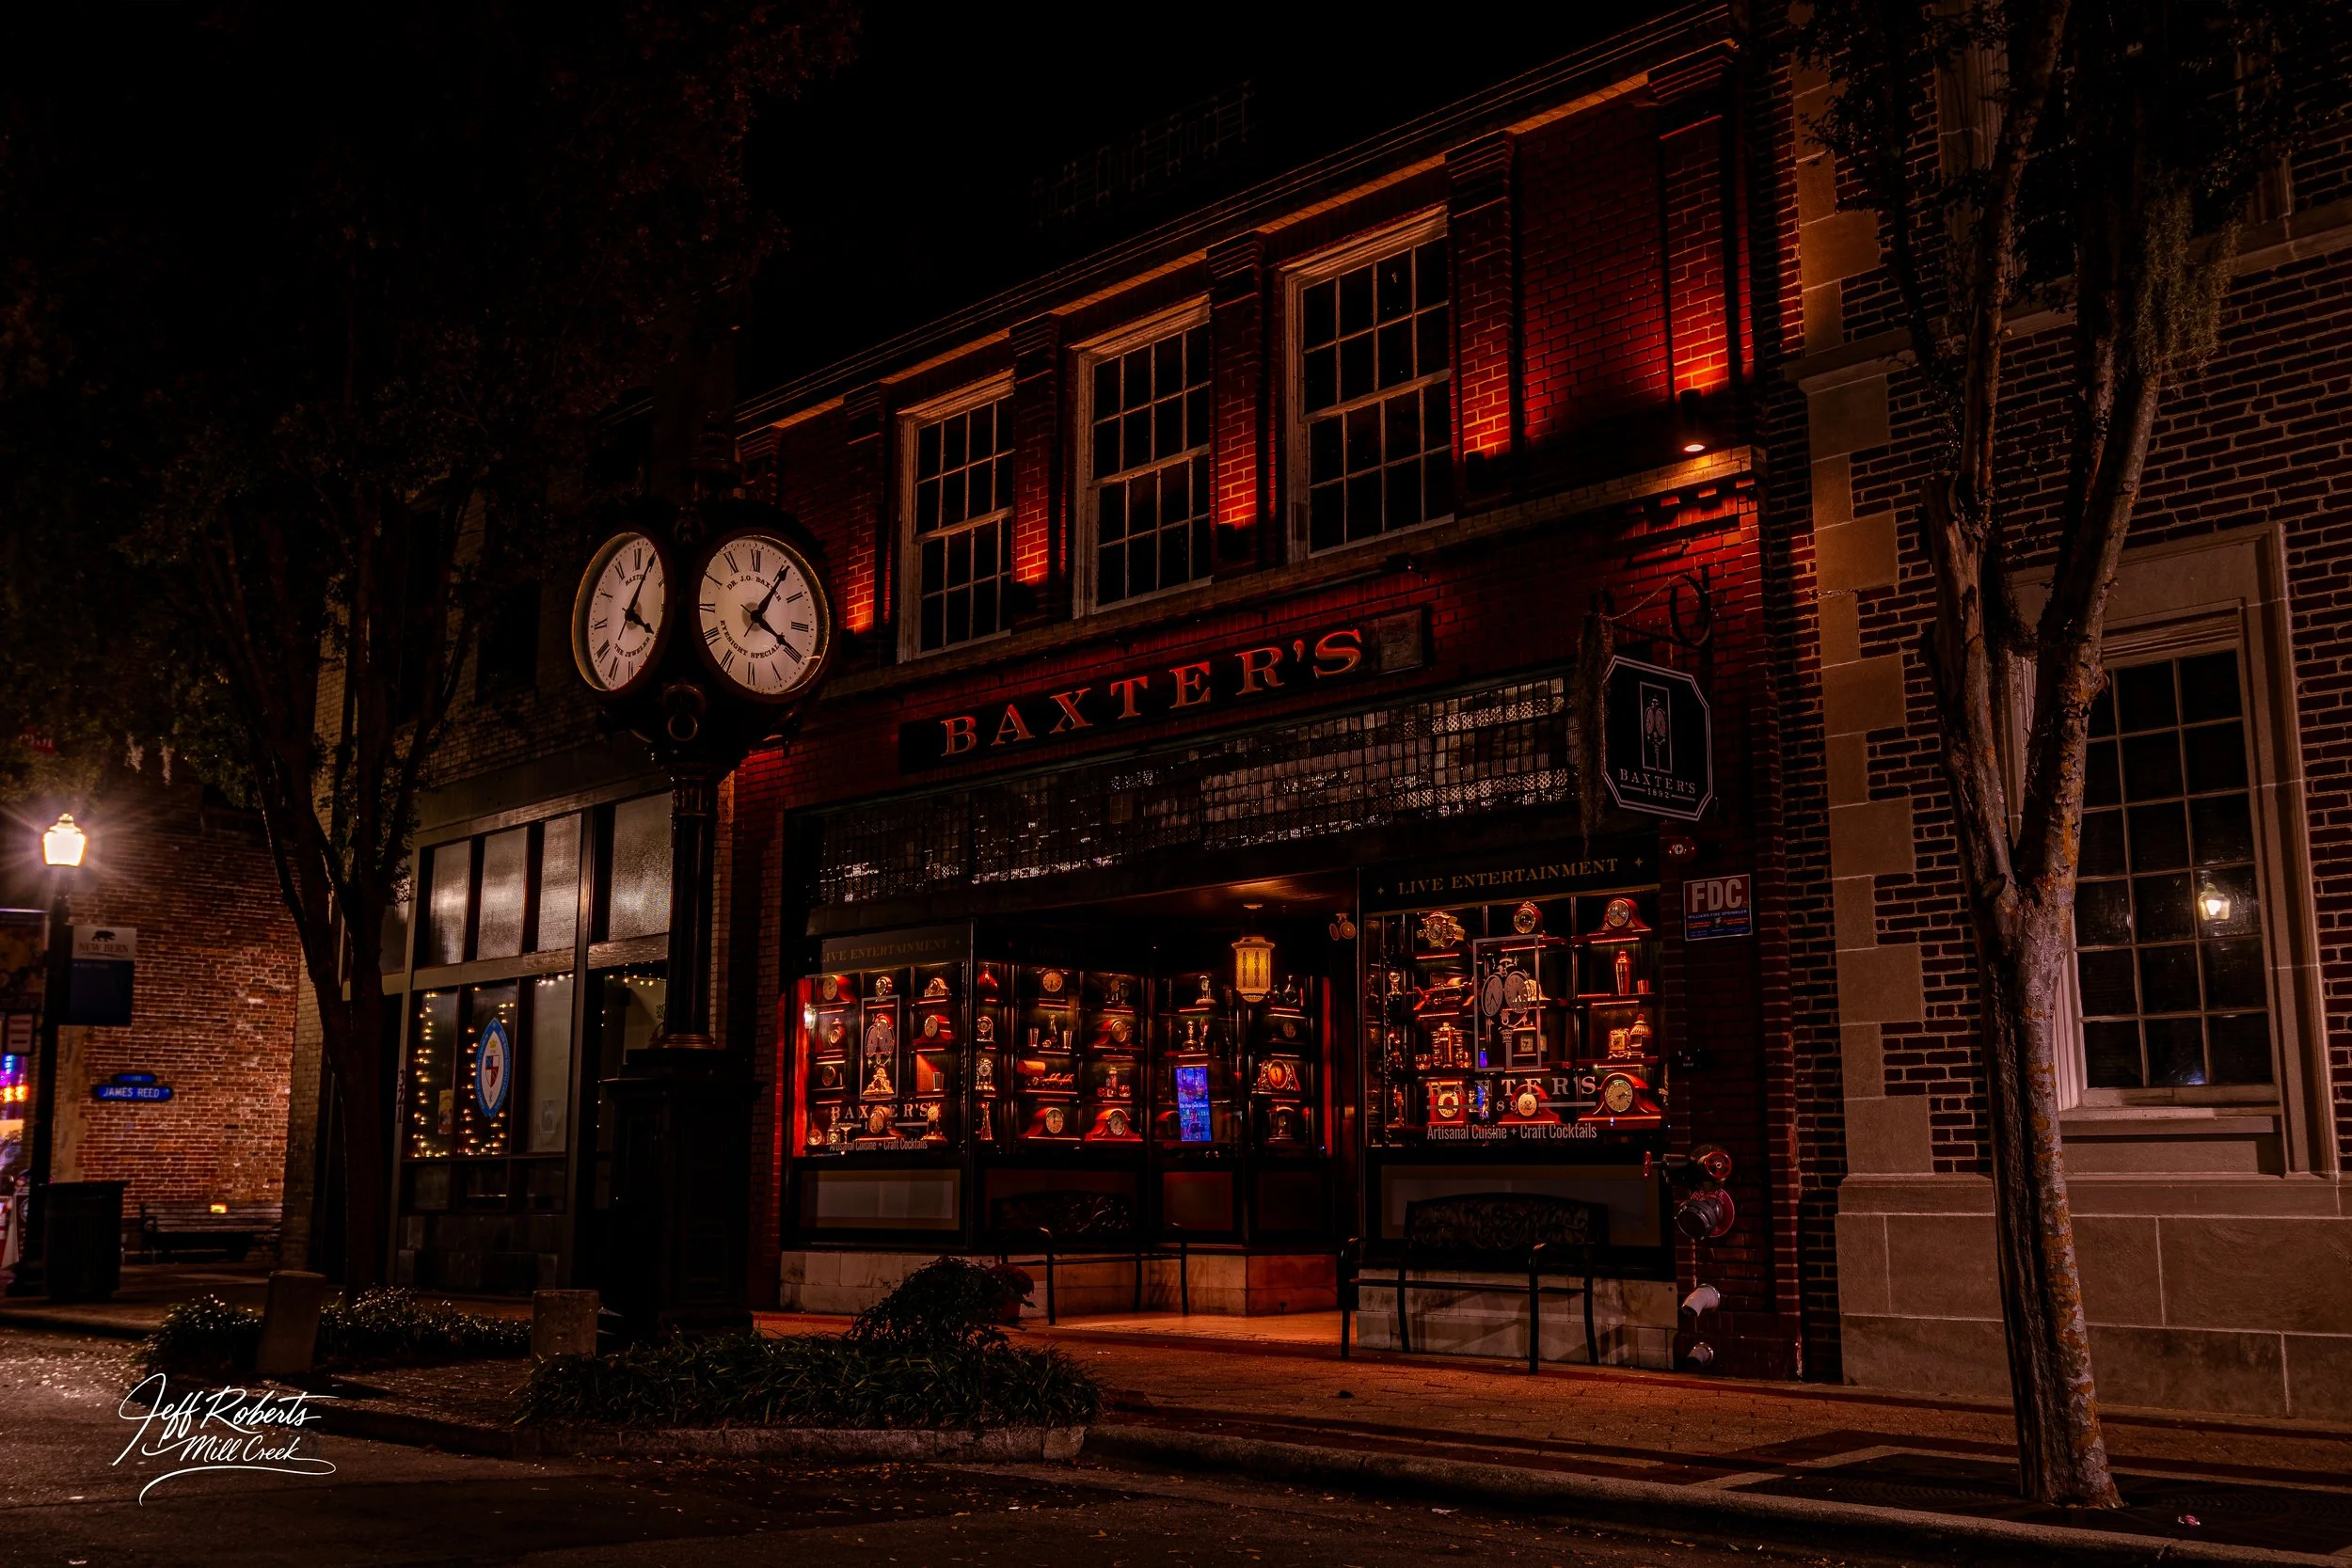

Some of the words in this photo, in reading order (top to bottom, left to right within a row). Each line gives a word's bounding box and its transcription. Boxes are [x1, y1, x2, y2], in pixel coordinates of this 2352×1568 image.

[726, 580, 739, 591] DR.
[755, 576, 783, 602] BAXER
[720, 620, 749, 657] EYESIGHT
[614, 643, 623, 657] THE
[940, 628, 1365, 757] BAXTER'S
[1619, 768, 1696, 795] BAXTER'S
[1647, 788, 1671, 799] 1892
[1398, 877, 1444, 895] LIVE
[1452, 858, 1618, 889] ENTERTAINMENT
[1692, 879, 1742, 912] FDC
[78, 942, 101, 953] NEW
[103, 942, 129, 954] BERN
[850, 939, 948, 959] ENTERTAINMENT
[103, 1086, 134, 1099] JAMES
[137, 1087, 160, 1099] REED
[1426, 1076, 1597, 1099] BAXTER'S
[831, 1102, 930, 1119] BAXER'S
[1486, 1100, 1532, 1112] 892
[1427, 1125, 1470, 1140] Artisanal
[1471, 1124, 1507, 1140] Cuisine
[1520, 1123, 1547, 1140] Craft
[1549, 1123, 1597, 1139] Cocktails
[882, 1138, 899, 1150] Craft
[899, 1138, 928, 1150] Cocktails
